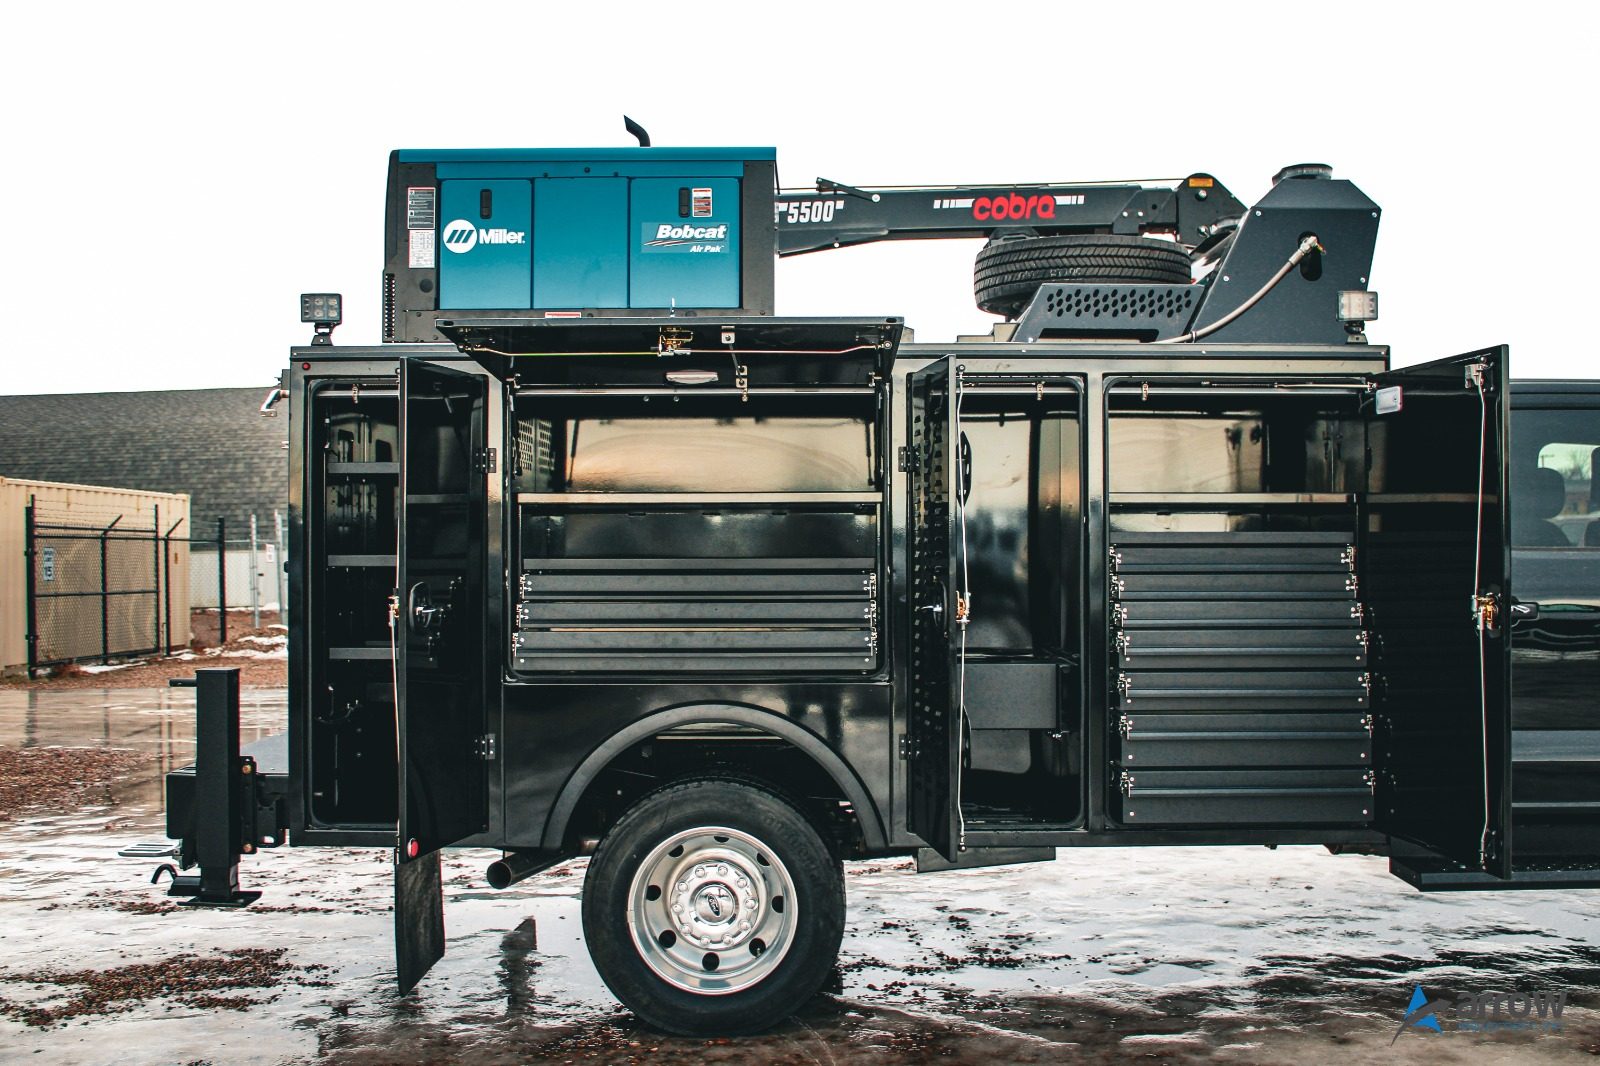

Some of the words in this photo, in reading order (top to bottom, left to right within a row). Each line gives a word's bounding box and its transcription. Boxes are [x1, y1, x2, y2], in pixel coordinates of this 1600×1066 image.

[787, 200, 835, 224] 5500
[973, 191, 1056, 221] cobra
[656, 224, 727, 239] Bobcat
[690, 245, 703, 253] Air
